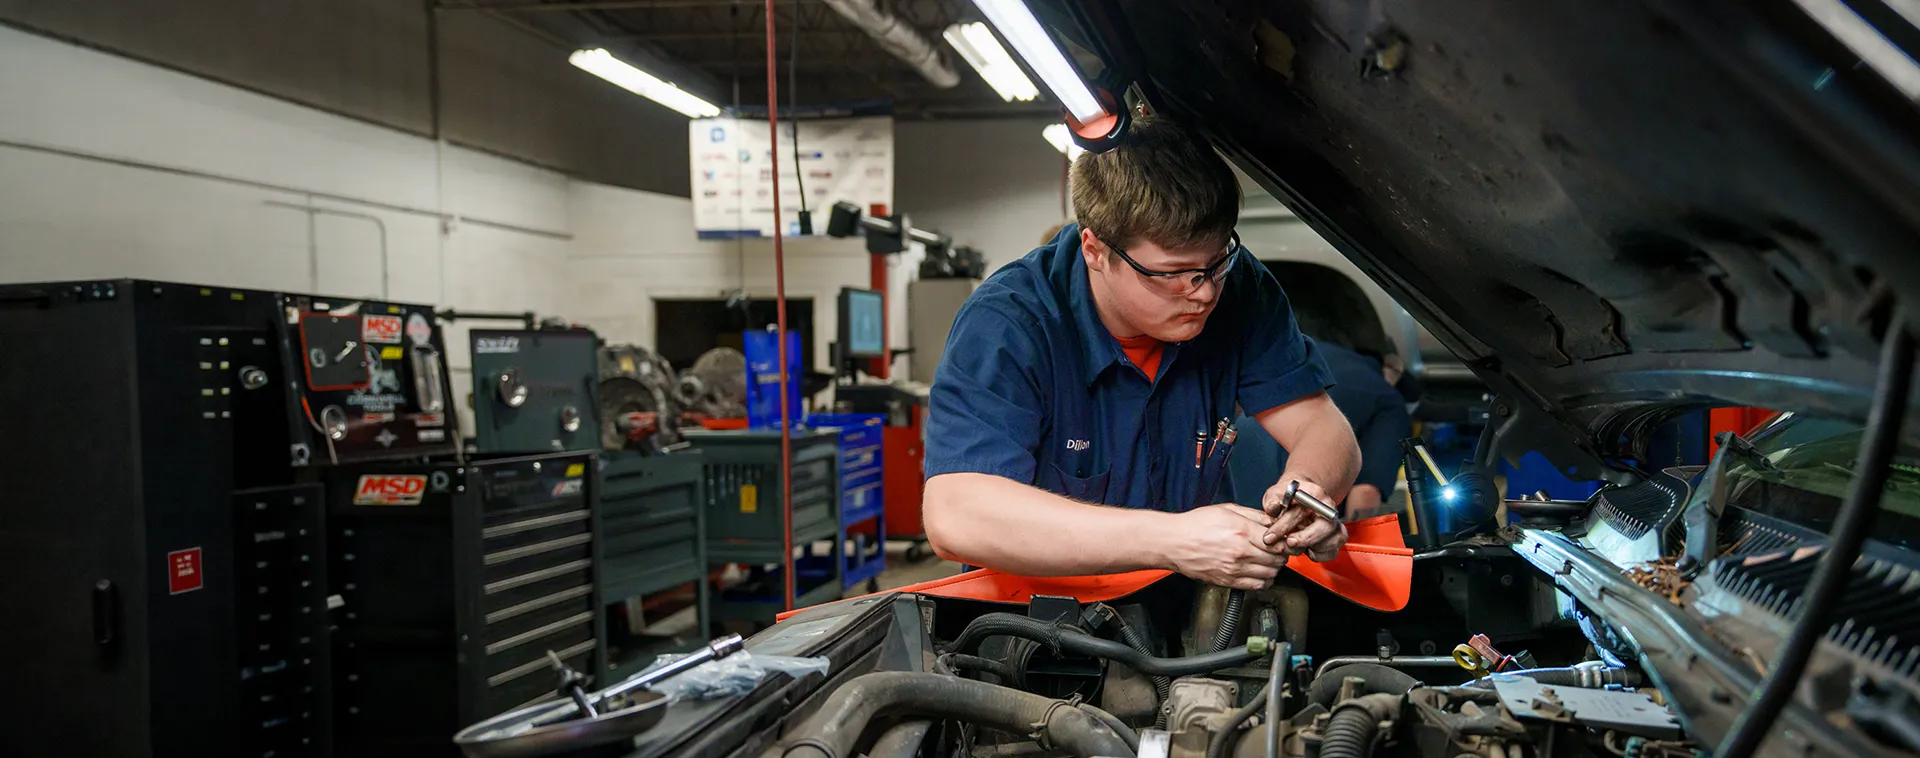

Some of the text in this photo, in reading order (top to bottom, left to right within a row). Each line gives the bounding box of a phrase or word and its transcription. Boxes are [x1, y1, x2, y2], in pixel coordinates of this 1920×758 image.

[366, 317, 401, 335] MSD
[1066, 439, 1090, 451] Dillon
[363, 475, 424, 495] MSD
